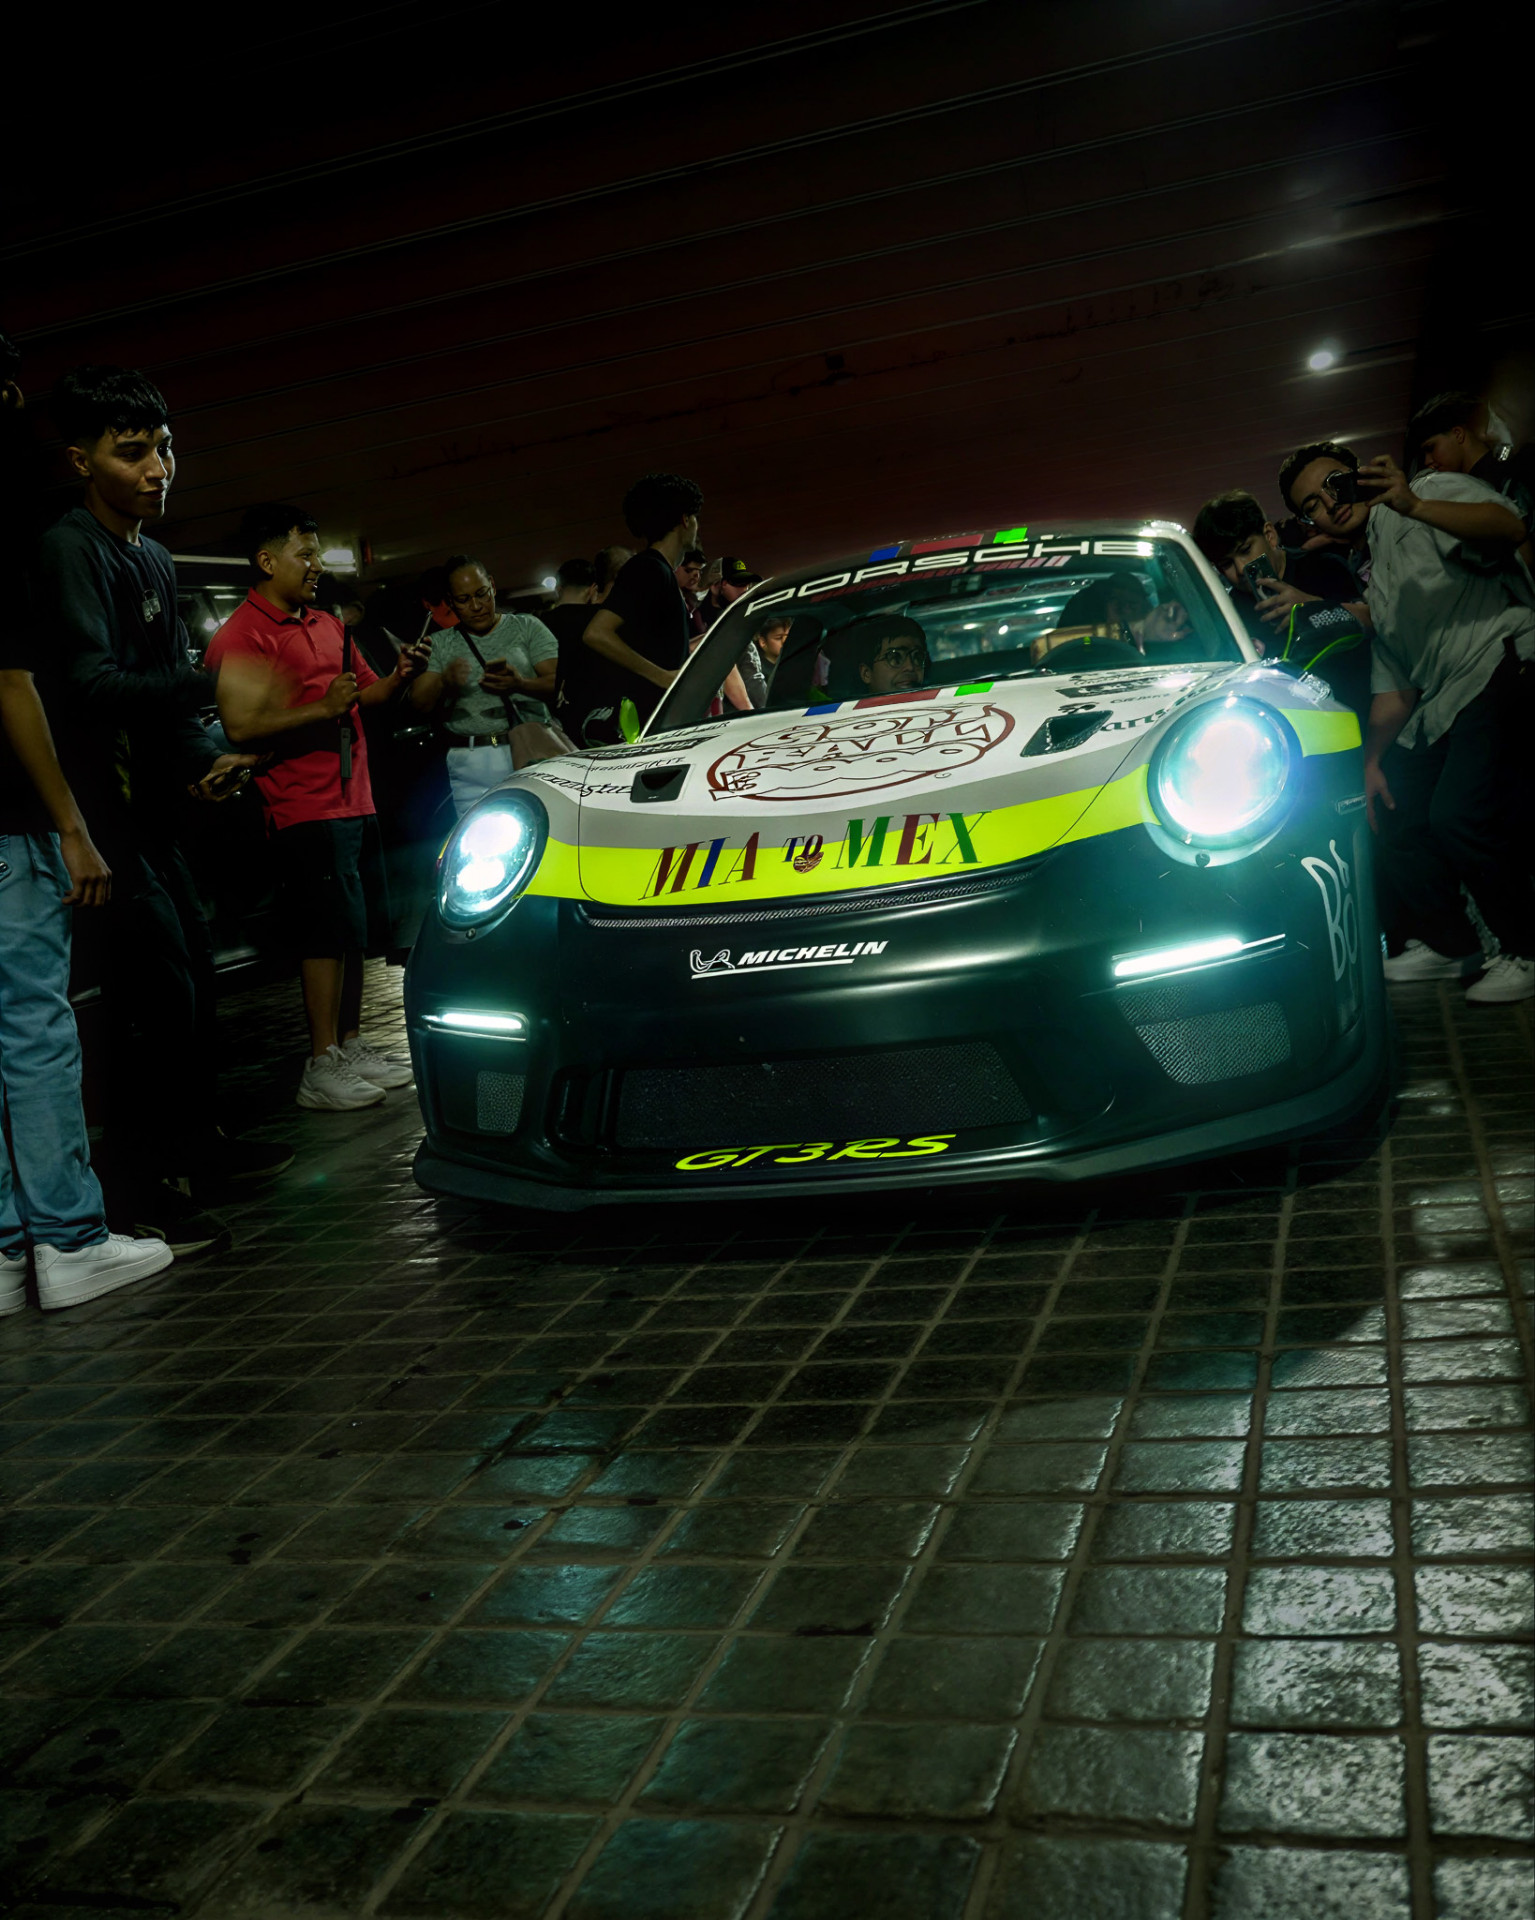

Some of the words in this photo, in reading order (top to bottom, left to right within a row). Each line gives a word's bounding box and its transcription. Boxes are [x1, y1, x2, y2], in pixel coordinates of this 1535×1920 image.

[744, 535, 1155, 618] PORSCHE
[637, 831, 761, 900] MIA
[781, 834, 824, 864] TO
[831, 810, 992, 870] MEX
[737, 940, 889, 966] MICHELIN
